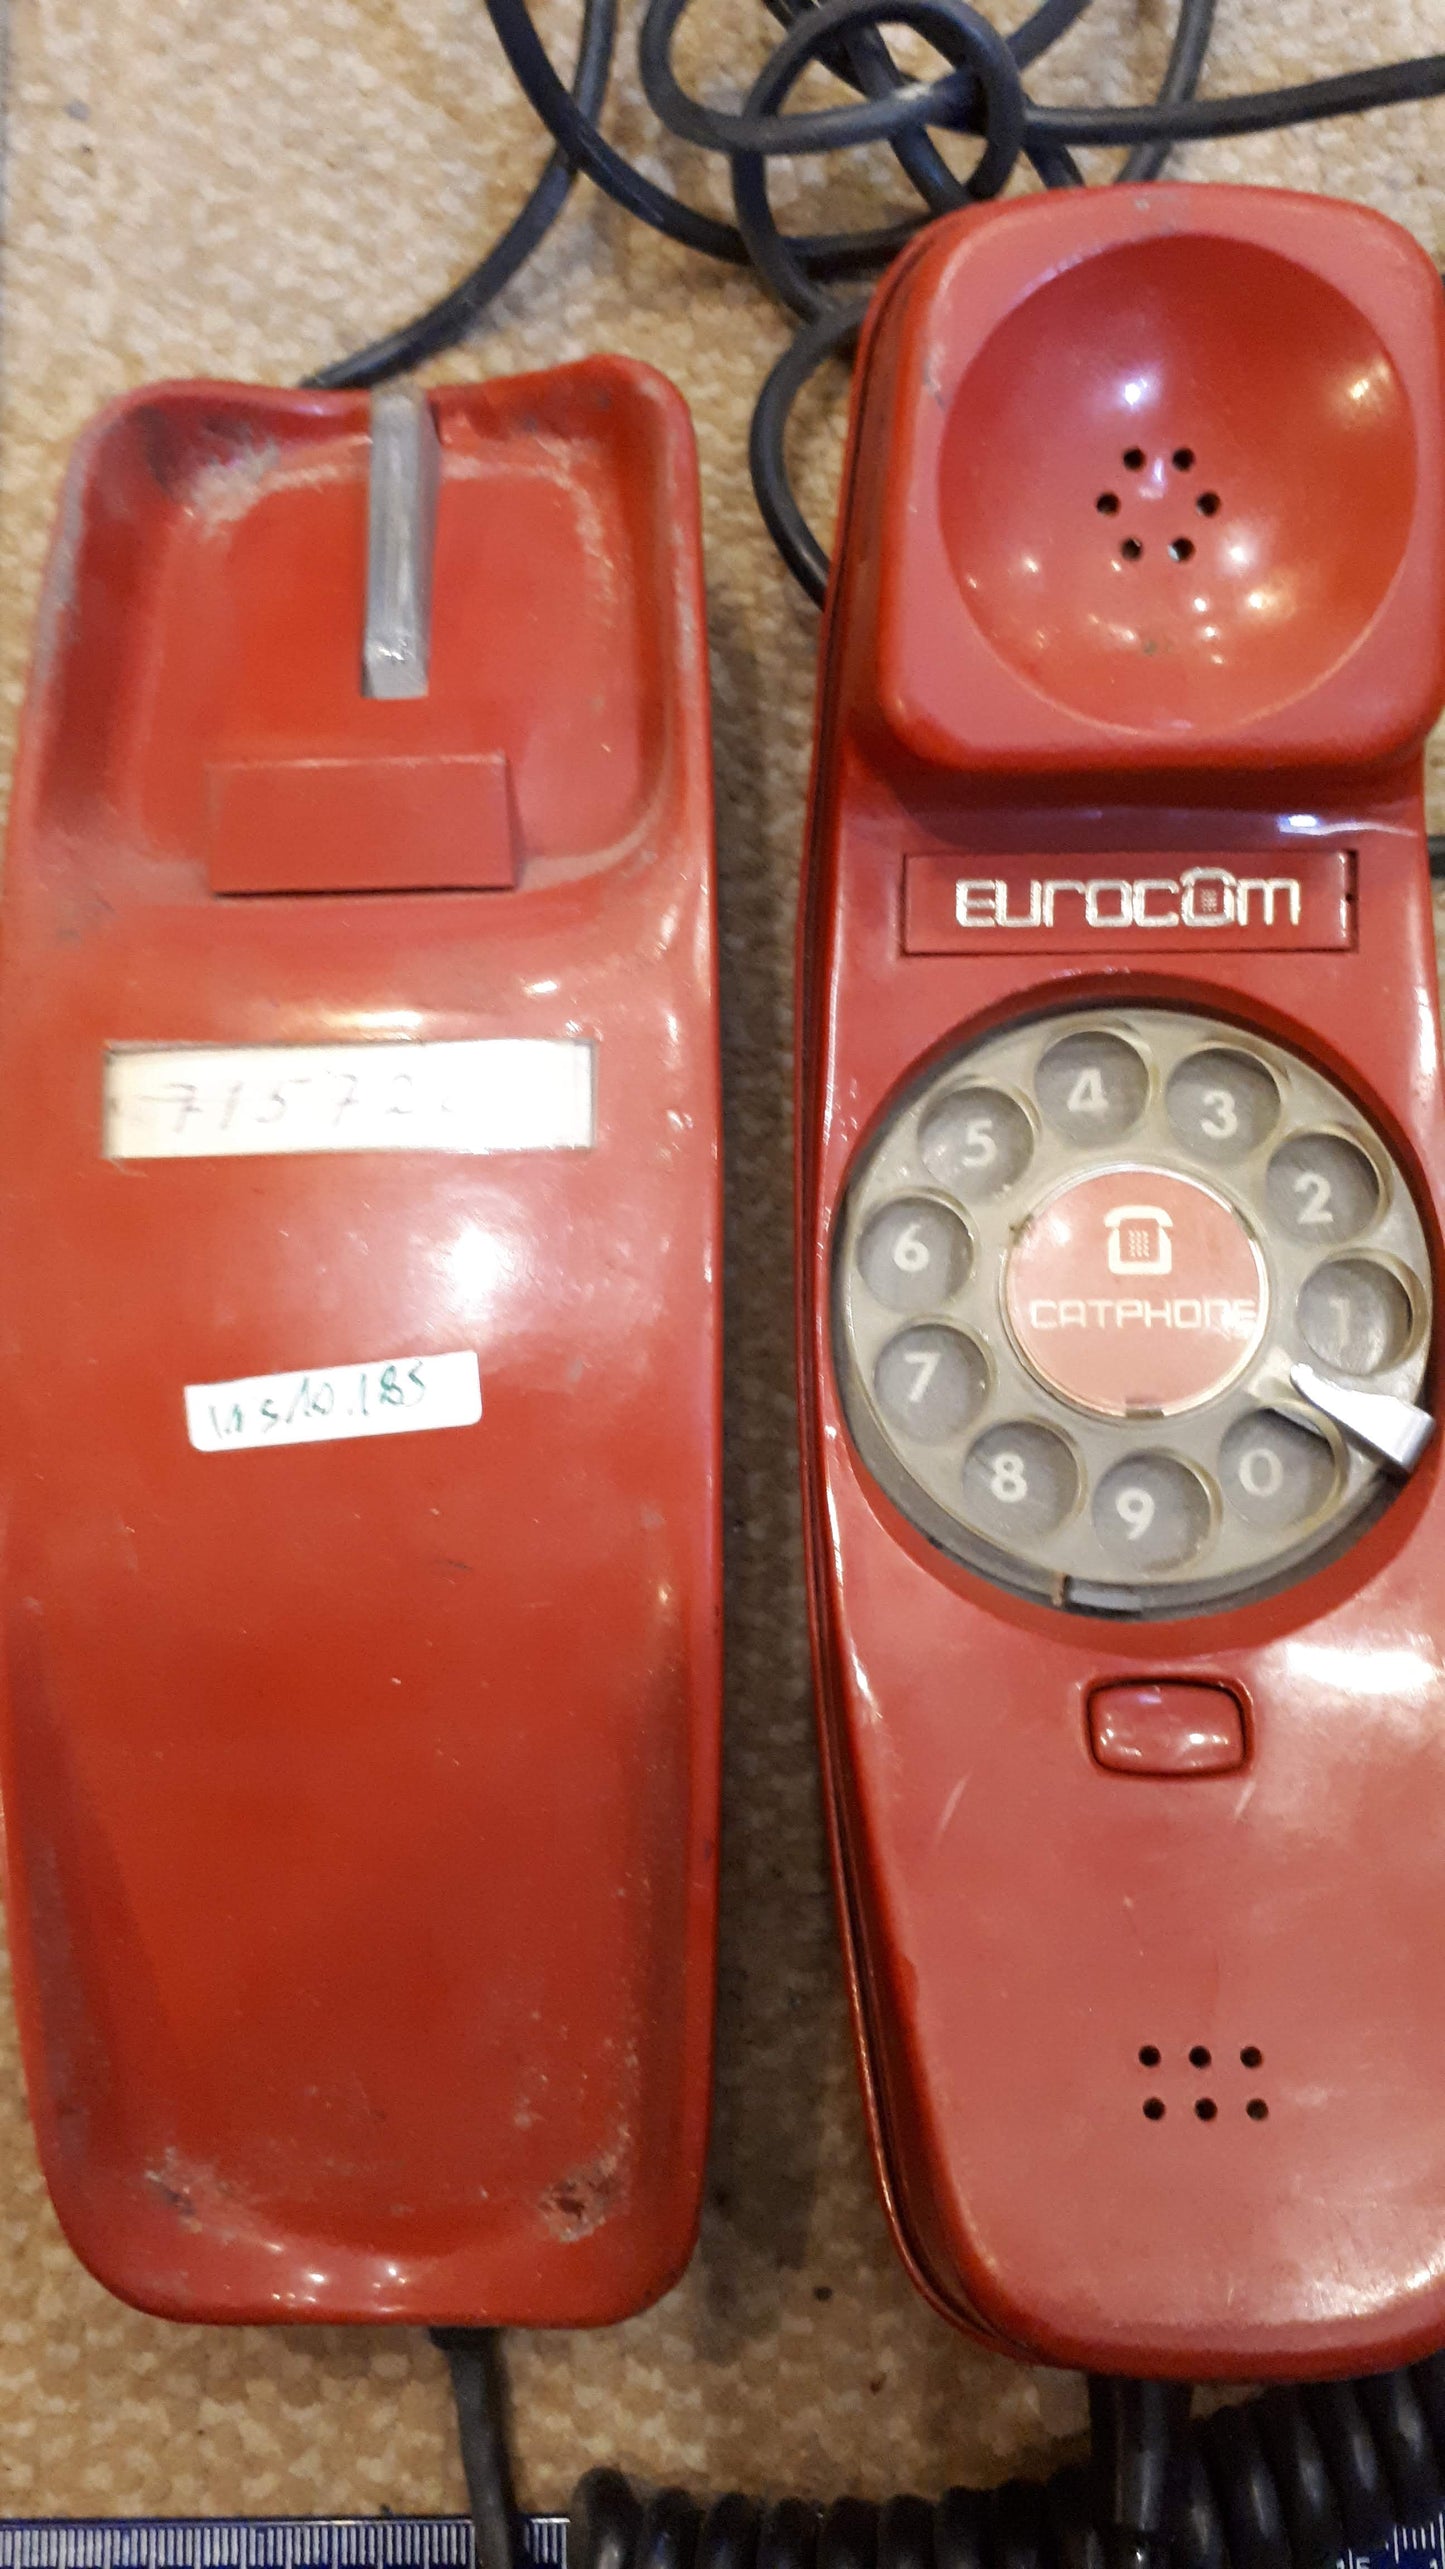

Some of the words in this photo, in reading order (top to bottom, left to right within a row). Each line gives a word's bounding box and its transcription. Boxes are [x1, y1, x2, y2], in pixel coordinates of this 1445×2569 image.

[1066, 1067, 1110, 1113] 4
[1201, 1091, 1238, 1139] 3
[960, 1119, 997, 1168] 5
[1294, 1174, 1334, 1225] 2
[893, 1222, 930, 1272] 6
[1030, 1298, 1258, 1331] CATPHONE
[1328, 1296, 1349, 1347] 1
[904, 1352, 939, 1403] 7
[991, 1452, 1028, 1503] 8
[1239, 1449, 1284, 1498] 0
[1115, 1489, 1155, 1541] 9
